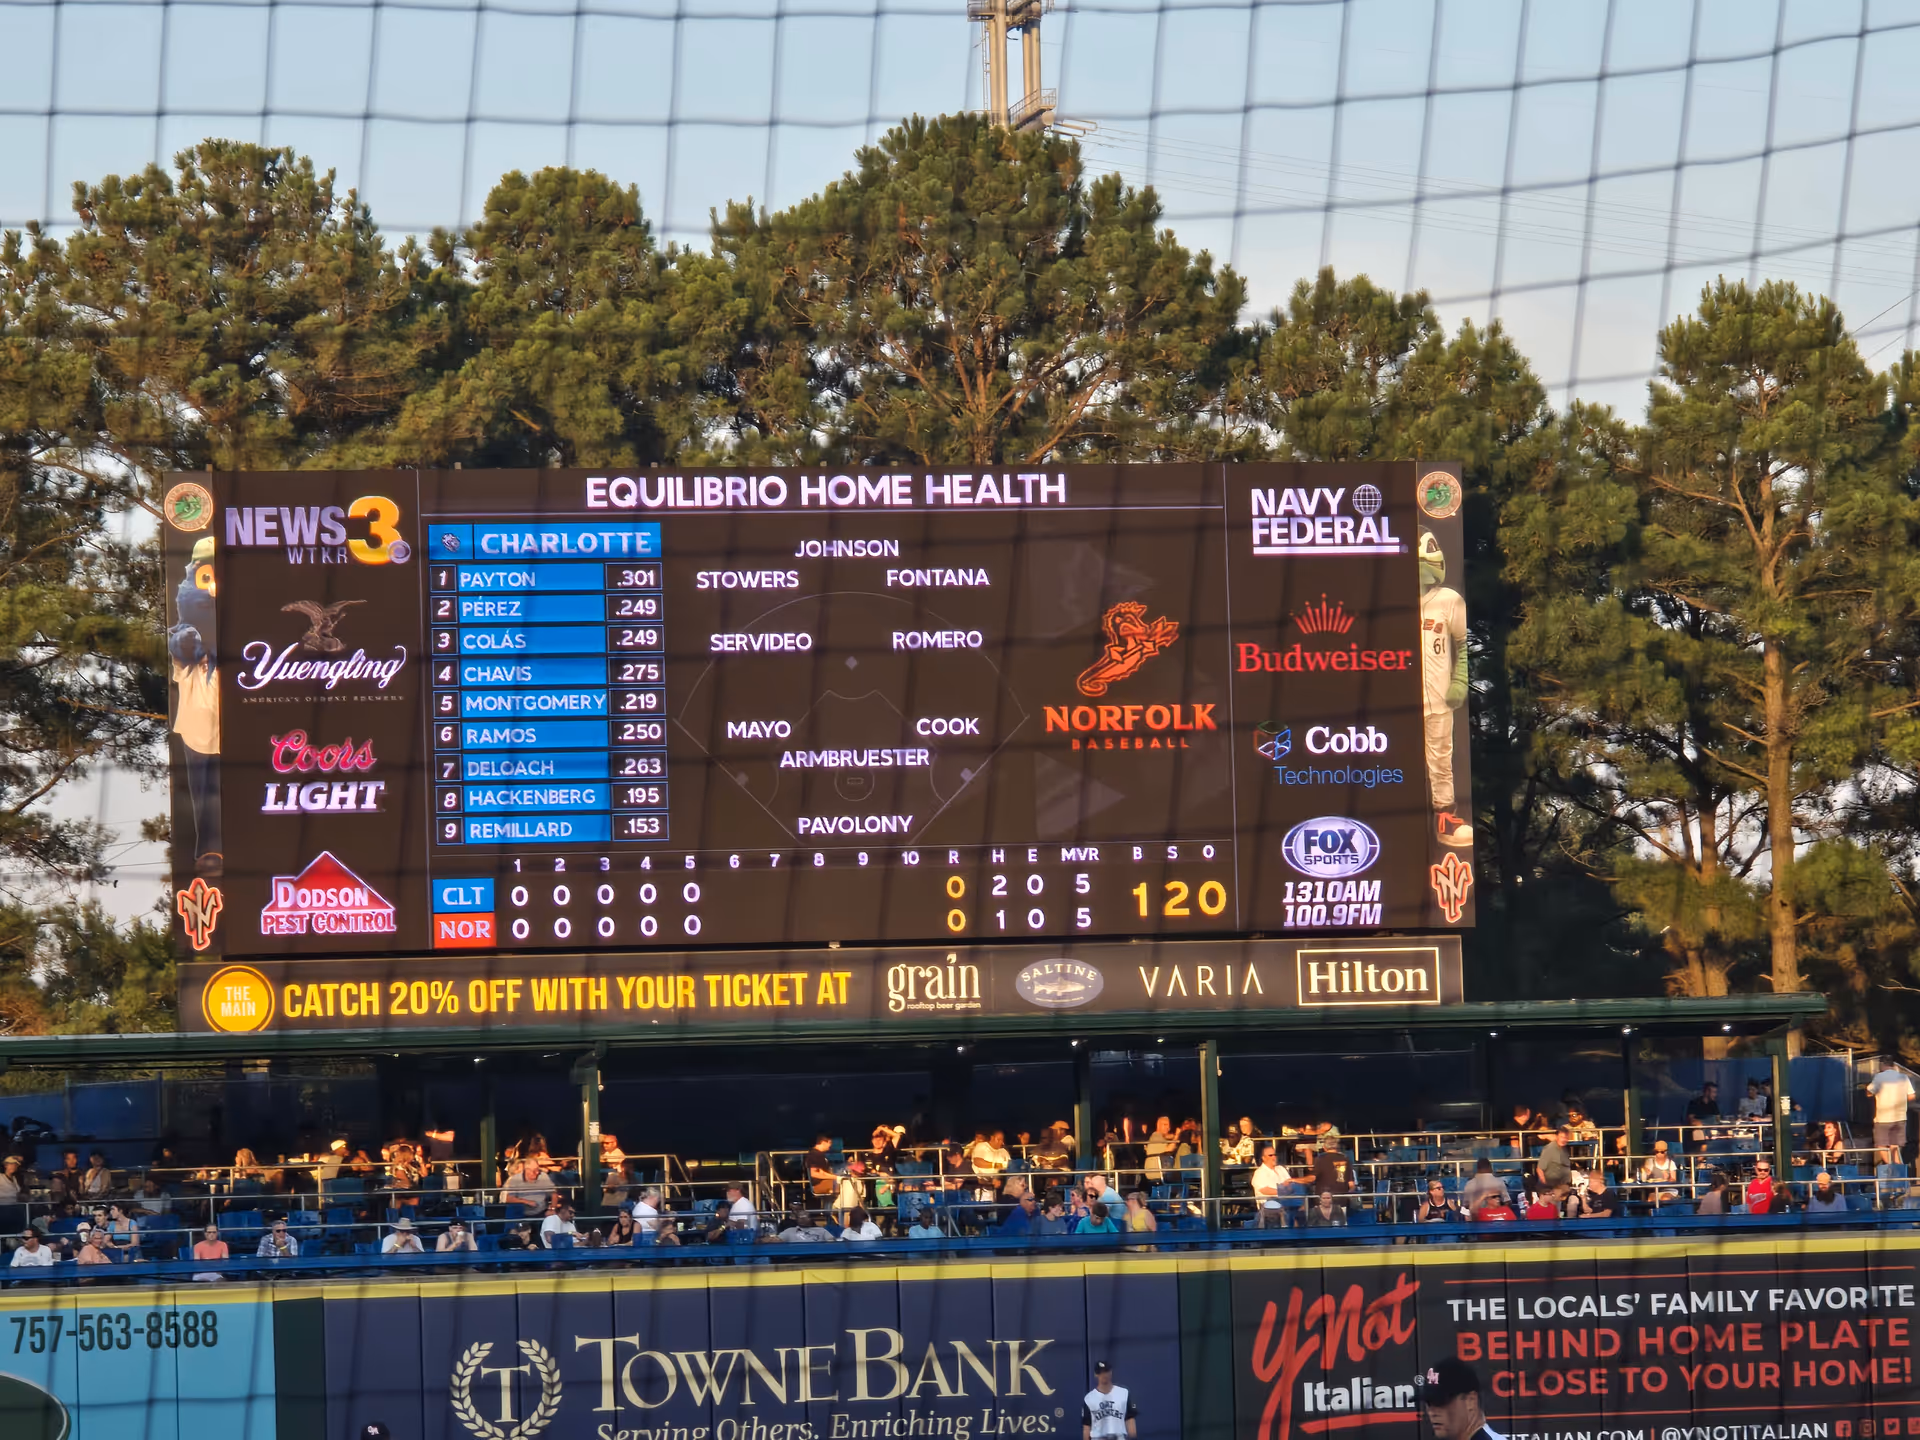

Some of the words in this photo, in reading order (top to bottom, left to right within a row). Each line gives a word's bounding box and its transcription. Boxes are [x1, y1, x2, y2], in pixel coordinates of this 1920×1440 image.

[586, 476, 788, 508] EQUILIBRIO
[800, 475, 913, 506] HOME
[925, 474, 1066, 505] HEALTH
[1250, 487, 1346, 516] NAVY
[225, 505, 347, 546] NEWS
[348, 496, 402, 565] 3
[1252, 516, 1400, 545] FEDERAL
[480, 532, 652, 554] CHARLOTTE
[794, 539, 899, 558] JOHNSON
[287, 547, 348, 564] WTKR
[439, 570, 447, 586] 1
[460, 571, 536, 588] PAYTON
[617, 570, 655, 586] .301
[696, 570, 800, 589] STOWERS
[886, 568, 990, 587] FONTANA
[437, 600, 450, 616] 2
[462, 596, 522, 617] PÉREZ
[615, 600, 656, 616] .249
[437, 632, 450, 648] 3
[463, 628, 526, 649] COLÁS
[616, 630, 658, 646] .249
[710, 633, 812, 651] SERVIDEO
[892, 630, 983, 649] ROMERO
[237, 641, 407, 690] Yuengling
[1236, 643, 1413, 672] Budweiser
[438, 665, 451, 681] 4
[464, 666, 532, 682] CHAVIS
[617, 664, 659, 681] .275
[440, 695, 452, 711] 5
[466, 694, 607, 711] MONTGOMERY
[620, 693, 657, 710] .219
[727, 720, 791, 738] MAYO
[916, 718, 980, 736] COOK
[1043, 703, 1217, 732] NORFOLK
[440, 726, 452, 741] 6
[466, 728, 537, 744] RAMOS
[617, 723, 662, 740] .250
[1071, 737, 1190, 750] BASEBALL
[1305, 726, 1388, 753] Cobb
[271, 729, 378, 773] Coors
[780, 749, 929, 768] ARMBRUESTER
[442, 762, 454, 778] 7
[467, 760, 554, 776] DELOACH
[619, 758, 662, 774] .263
[1273, 765, 1403, 788] Technologies
[261, 781, 386, 813] LIGHT
[443, 792, 456, 808] 8
[469, 789, 596, 806] HACKENBERG
[623, 787, 660, 804] .195
[444, 823, 457, 838] 9
[470, 822, 573, 838] REMILLARD
[624, 818, 660, 834] .153
[797, 815, 913, 834] PAVOLONY
[1303, 829, 1359, 854] FOX
[514, 858, 521, 872] 1
[555, 858, 566, 872] 2
[600, 857, 610, 871] 3
[640, 856, 651, 870] 4
[685, 855, 696, 869] 5
[729, 855, 740, 868] 6
[770, 854, 780, 867] 7
[814, 853, 824, 866] 8
[858, 852, 869, 865] 9
[902, 851, 919, 865] 10
[948, 850, 959, 864] R
[992, 849, 1005, 863] H
[1028, 848, 1038, 862] E
[1061, 847, 1099, 862] MVR
[1132, 846, 1143, 860] B
[1167, 846, 1178, 859] S
[1303, 855, 1359, 865] SPORTS
[277, 881, 369, 909] DODSON
[442, 886, 485, 906] CLT
[511, 885, 529, 906] 0
[553, 885, 571, 905] 0
[597, 884, 615, 905] 0
[639, 883, 657, 904] 0
[683, 882, 701, 903] 0
[946, 875, 965, 898] 0
[992, 874, 1008, 896] 2
[1026, 874, 1044, 895] 0
[1075, 873, 1091, 894] 5
[1132, 882, 1148, 917] 1
[1164, 880, 1190, 916] 2
[1198, 880, 1227, 916] 0
[1282, 880, 1382, 903] 1310AM
[262, 912, 308, 934] PEST
[313, 911, 398, 933] CONTROL
[439, 920, 491, 939] NOR
[511, 918, 530, 939] 0
[554, 917, 572, 938] 0
[597, 916, 616, 937] 0
[640, 915, 658, 936] 0
[683, 914, 701, 935] 0
[947, 908, 966, 932] 0
[996, 909, 1005, 929] 1
[1027, 908, 1045, 929] 0
[1076, 907, 1092, 928] 5
[1283, 903, 1382, 927] 100.9FM
[887, 953, 981, 1013] grain
[1021, 964, 1097, 982] SALTINE
[1138, 962, 1264, 998] VARIA
[1307, 960, 1429, 994] Hilton
[224, 986, 251, 1001] THE
[283, 982, 380, 1018] CATCH
[389, 980, 459, 1015] 20%
[468, 978, 523, 1013] OFF
[531, 977, 608, 1012] WITH
[616, 975, 696, 1010] YOUR
[704, 972, 808, 1008] TICKET
[816, 971, 852, 1005] AT
[220, 1001, 256, 1017] MAIN
[1446, 1297, 1507, 1322] THE
[1517, 1293, 1640, 1320] LOCALS’
[1650, 1289, 1759, 1316] FAMILY
[1769, 1284, 1915, 1311] FAVORITE
[10, 1310, 218, 1354] 757-563-8588
[1456, 1327, 1622, 1362] BEHIND
[1638, 1322, 1764, 1356] HOME
[1780, 1317, 1910, 1352] PLATE
[1492, 1368, 1609, 1398] CLOSE
[1619, 1366, 1668, 1394] TO
[1679, 1361, 1780, 1392] YOUR
[1793, 1356, 1913, 1388] HOME!
[597, 1420, 710, 1440] Serving
[716, 1416, 819, 1440] Others.
[829, 1409, 973, 1440] Enriching
